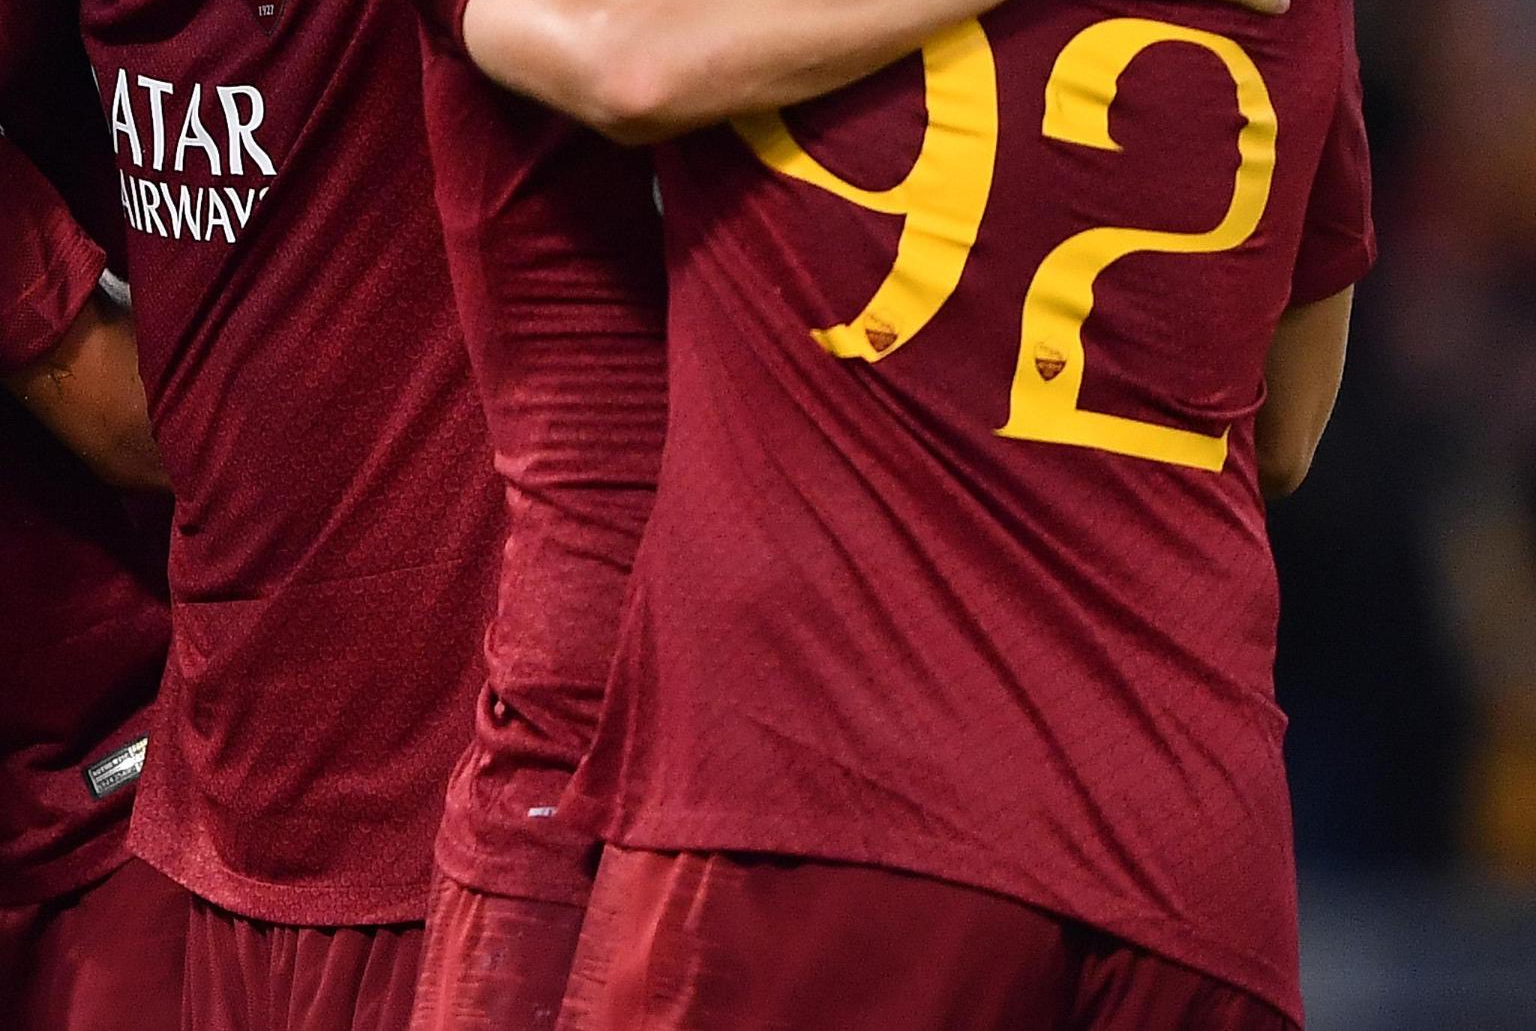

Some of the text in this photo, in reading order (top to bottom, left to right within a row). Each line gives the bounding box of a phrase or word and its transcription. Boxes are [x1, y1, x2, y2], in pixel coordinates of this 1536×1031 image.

[258, 4, 275, 17] 1927
[112, 68, 277, 176] ATAR
[120, 169, 270, 243] AIRWAY
[729, 18, 1278, 473] 92
